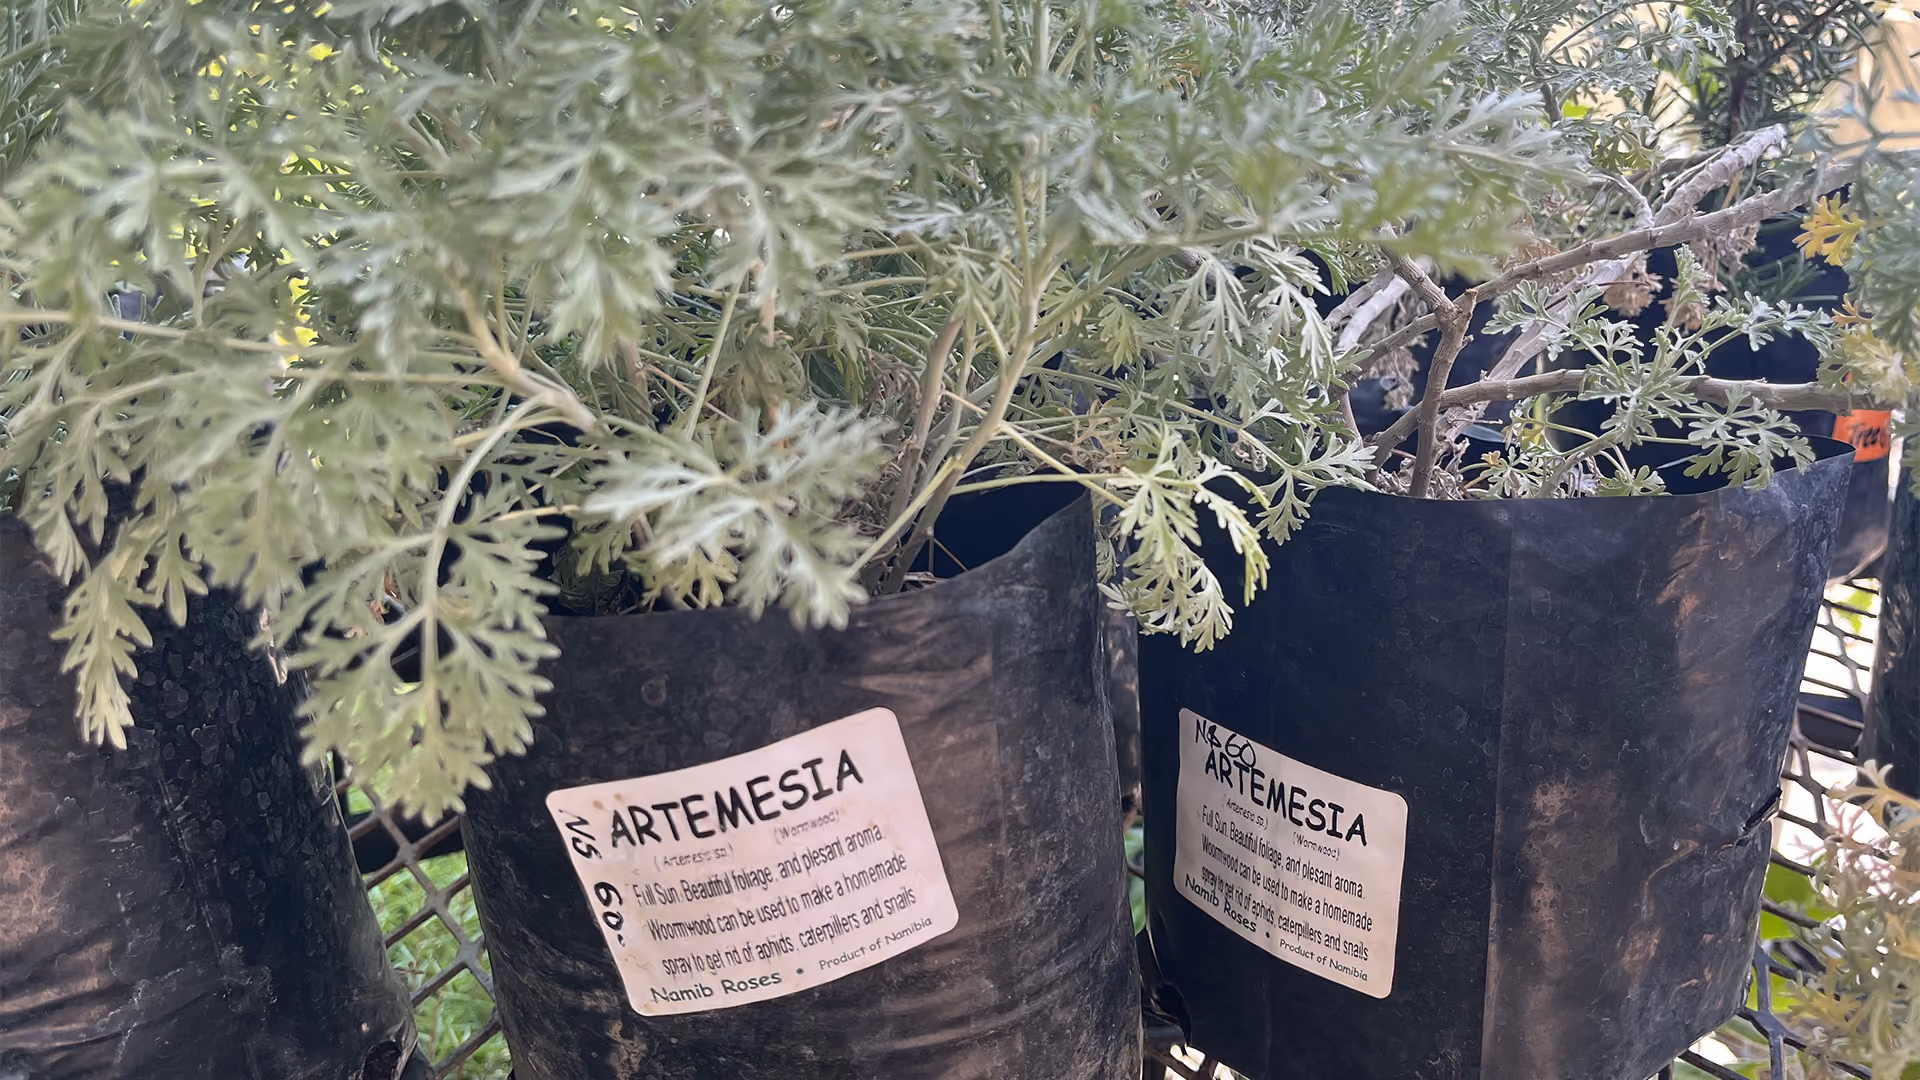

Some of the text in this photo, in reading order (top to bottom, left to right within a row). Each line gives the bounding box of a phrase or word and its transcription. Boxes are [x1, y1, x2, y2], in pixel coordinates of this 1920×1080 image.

[1205, 748, 1367, 847] ARTEMESIA
[1225, 733, 1256, 768] 60
[611, 749, 864, 848] ARTEMESIA
[632, 883, 654, 907] Full
[681, 873, 733, 902] Beautiful
[778, 852, 802, 879] and
[802, 837, 845, 877] plesant
[647, 852, 908, 941] Woormwood can be used to make a homemade
[1202, 805, 1213, 828] Full
[1229, 821, 1258, 854] Beautiful
[1259, 837, 1284, 870] foliage,
[1285, 856, 1301, 874] and
[1302, 860, 1333, 889] plesant
[1335, 875, 1367, 899] aroma.
[1202, 833, 1372, 932] Woormwood can be used to make a homemade
[650, 916, 933, 1004] Namib Roses Product of Namibia
[662, 954, 693, 982] spray
[692, 952, 705, 972] to
[705, 948, 723, 975] get
[726, 945, 742, 967] rid
[742, 939, 754, 963] of
[799, 911, 860, 948] caterpillers
[861, 898, 883, 926] and
[884, 886, 917, 915] snails
[1185, 873, 1368, 981] Namib Roses Product of Namibia
[1202, 866, 1217, 891] spray
[1217, 875, 1224, 892] to
[1225, 881, 1234, 901] get
[1235, 886, 1243, 907] rid
[1244, 893, 1252, 911] of
[1278, 914, 1322, 945] caterpillers
[1324, 933, 1341, 952] and
[1343, 939, 1369, 961] snails
